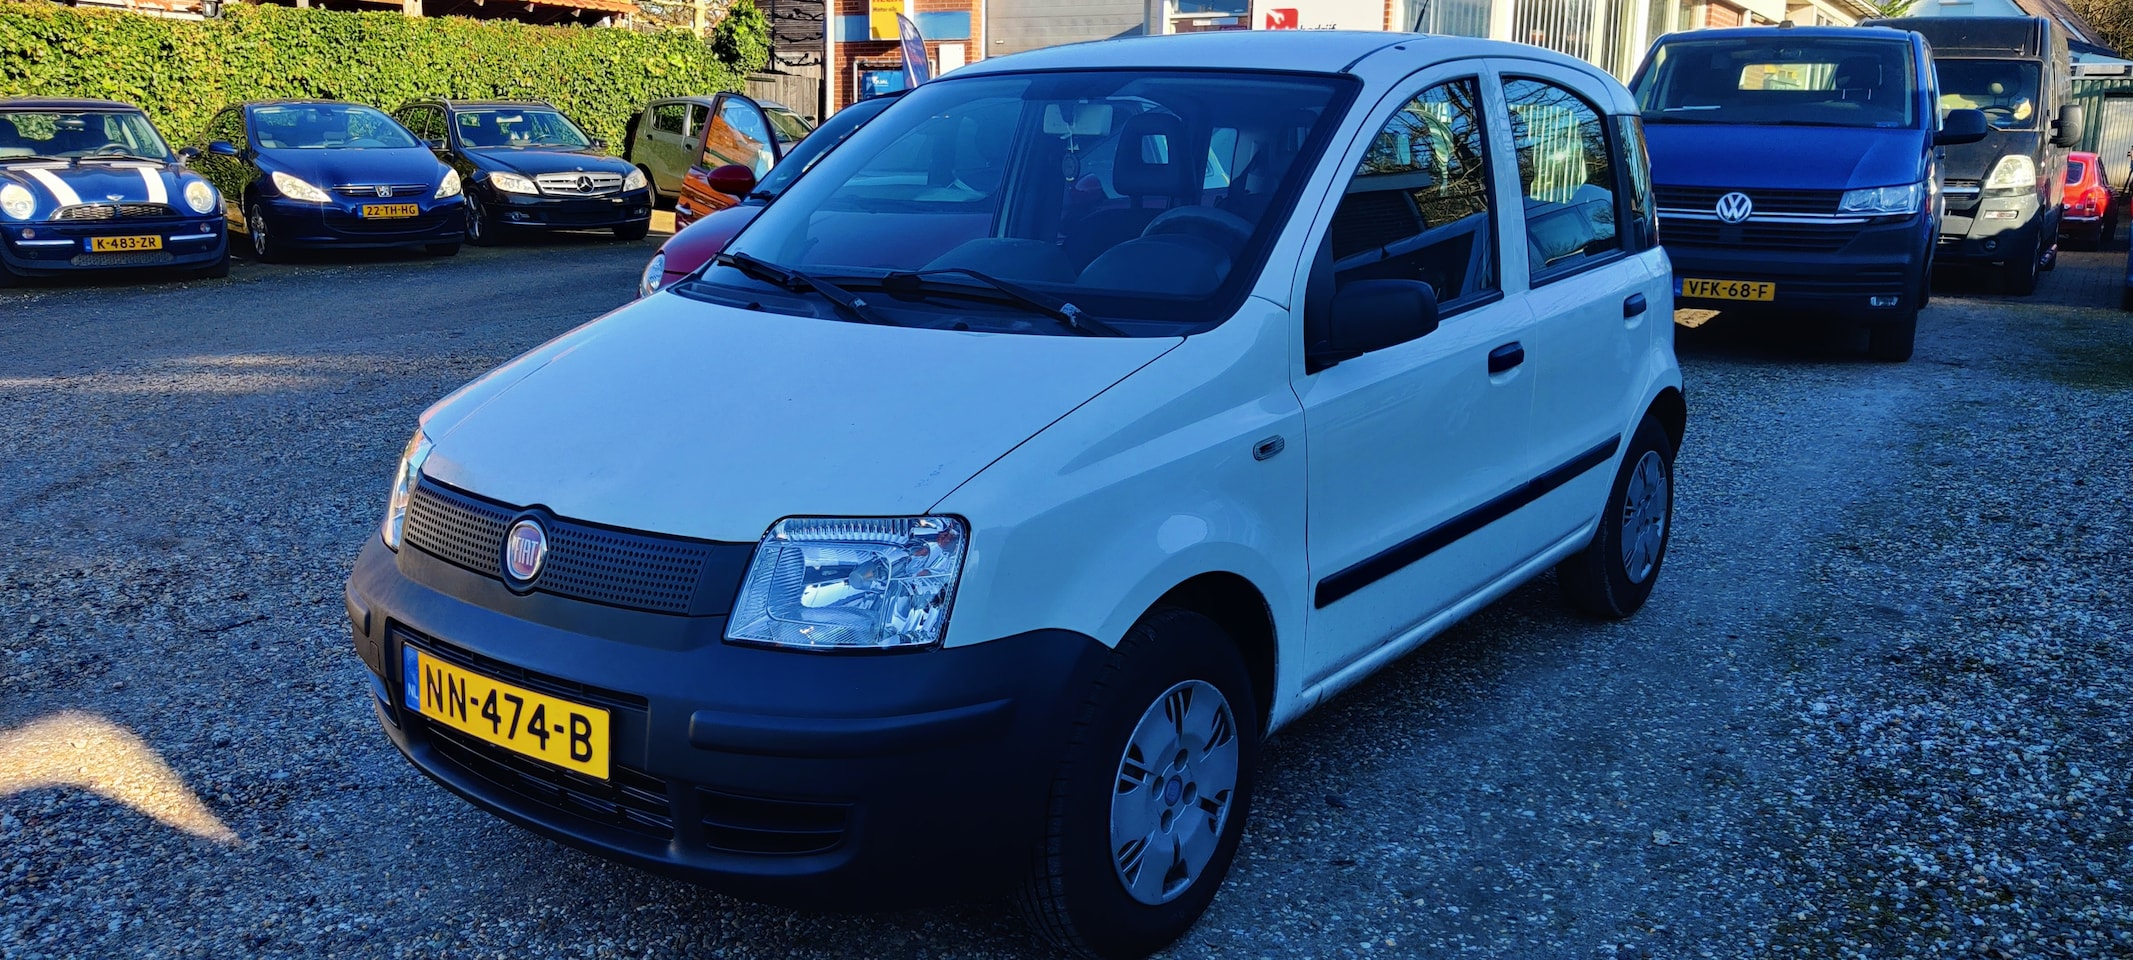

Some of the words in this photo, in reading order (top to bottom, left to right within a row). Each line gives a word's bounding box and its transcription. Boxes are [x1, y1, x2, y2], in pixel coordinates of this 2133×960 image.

[366, 205, 416, 216] 22-TH-HG
[97, 237, 157, 249] K-483-ZR
[1689, 280, 1769, 298] VFK-68-F
[514, 535, 539, 567] FIAT
[408, 682, 419, 700] NL
[426, 663, 593, 763] NN-474-B
